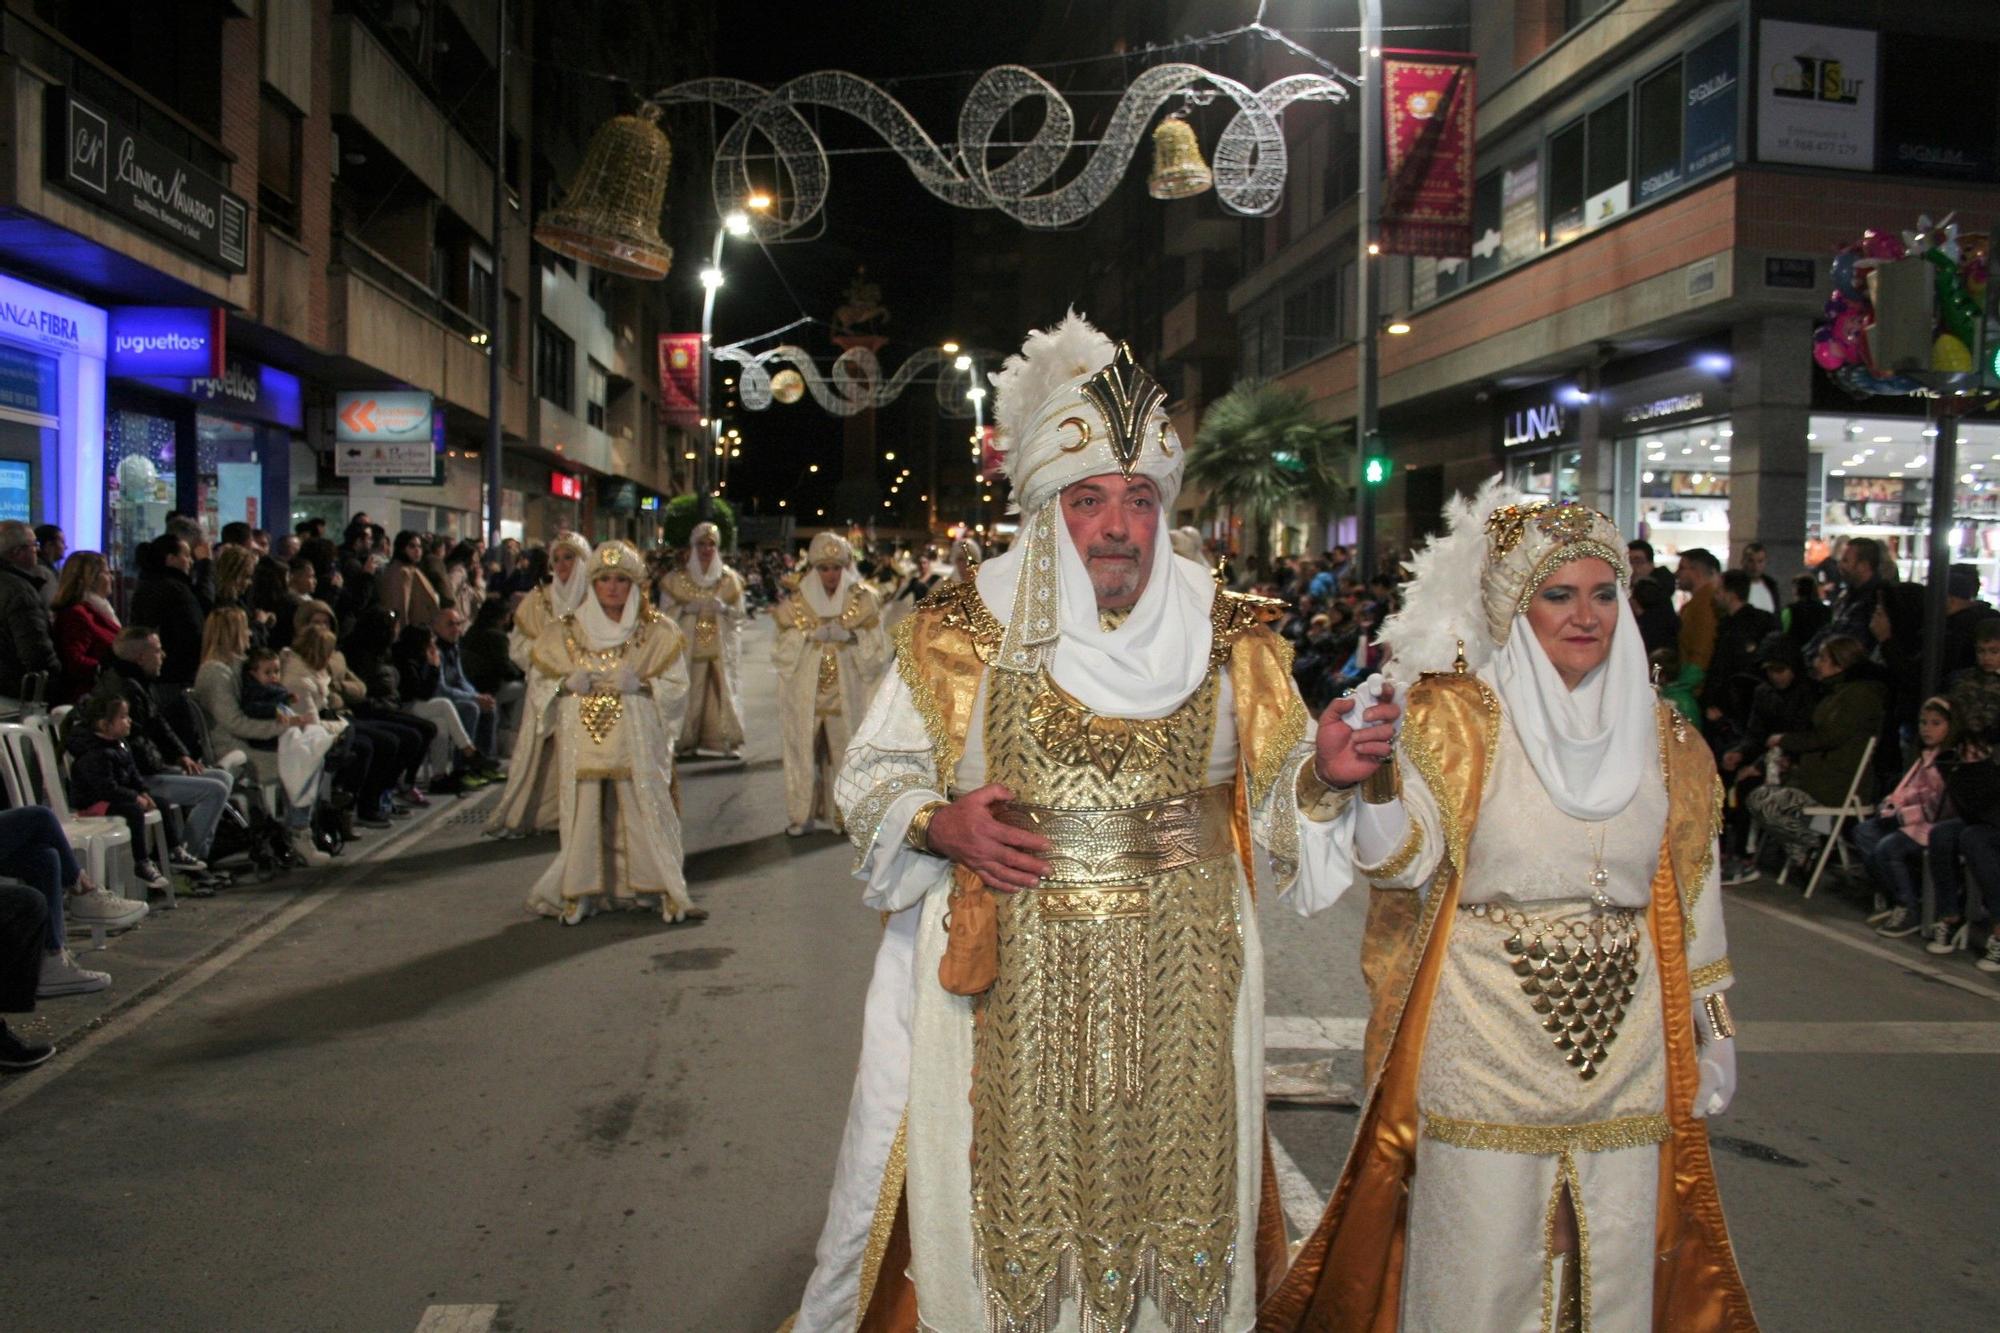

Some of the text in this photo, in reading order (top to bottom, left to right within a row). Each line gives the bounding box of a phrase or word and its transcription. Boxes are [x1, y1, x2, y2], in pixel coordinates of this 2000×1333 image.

[160, 168, 215, 230] NAVARRO
[116, 332, 201, 354] juguettos
[1503, 402, 1562, 447] LUNA
